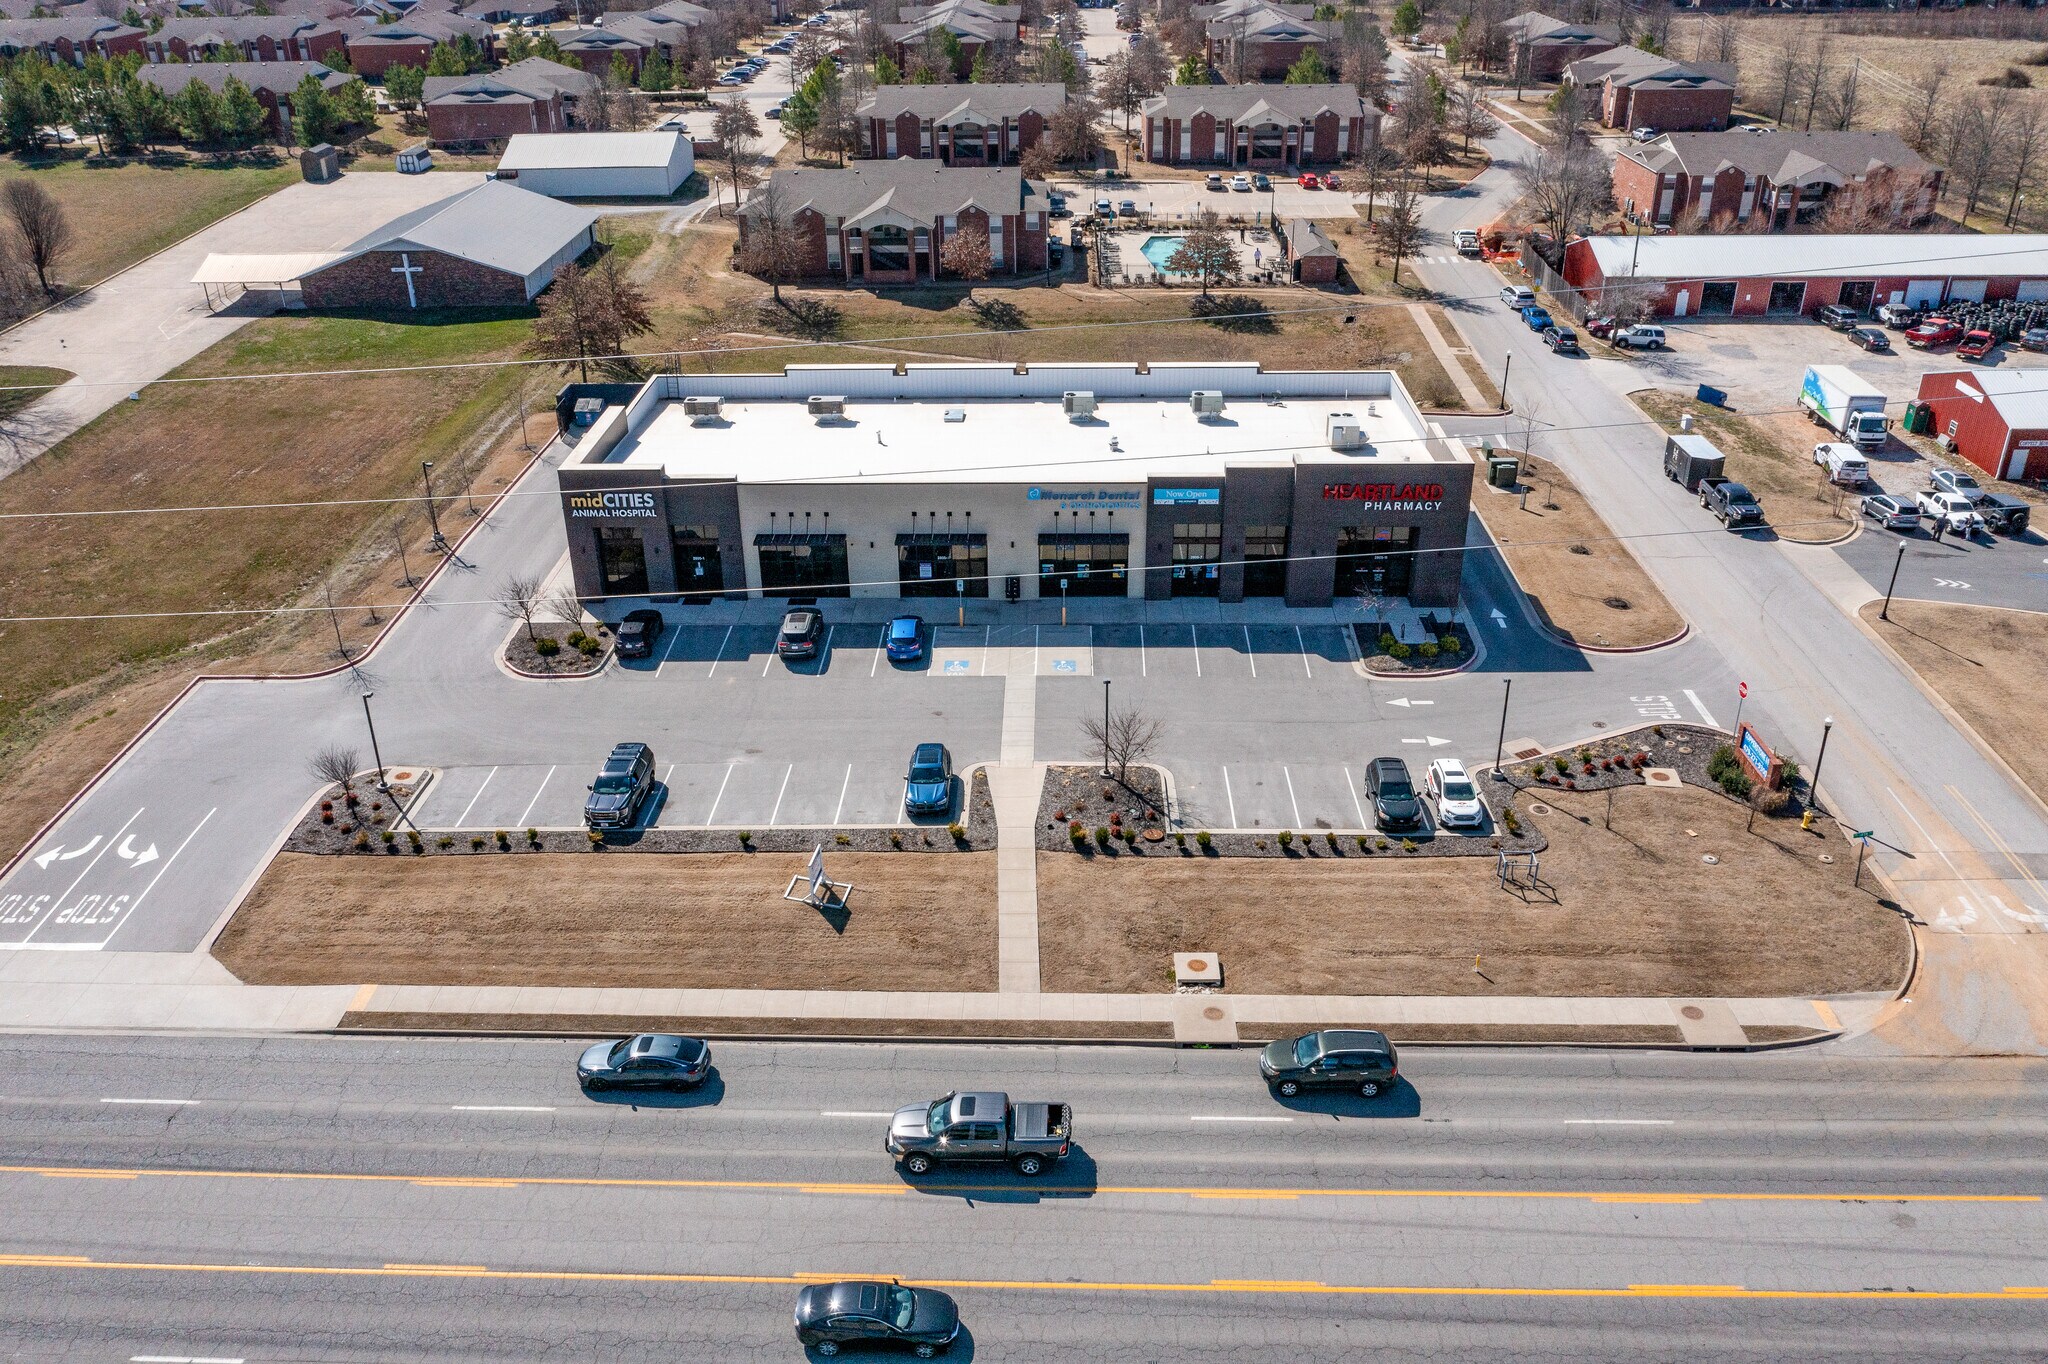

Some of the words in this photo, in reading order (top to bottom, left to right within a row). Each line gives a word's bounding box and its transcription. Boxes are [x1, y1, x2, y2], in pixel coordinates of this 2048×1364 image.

[1040, 488, 1096, 500] Monarch
[1098, 488, 1141, 500] Dental
[1166, 490, 1185, 498] Now
[1186, 490, 1208, 499] Open
[1323, 484, 1444, 500] HEARTLAND
[570, 492, 655, 508] midCITIES
[1364, 501, 1442, 510] PHARMACY
[572, 509, 611, 517] ANIMAL
[612, 509, 658, 517] HOSPITAL
[1629, 695, 1682, 720] STOP
[55, 894, 130, 924] STOP
